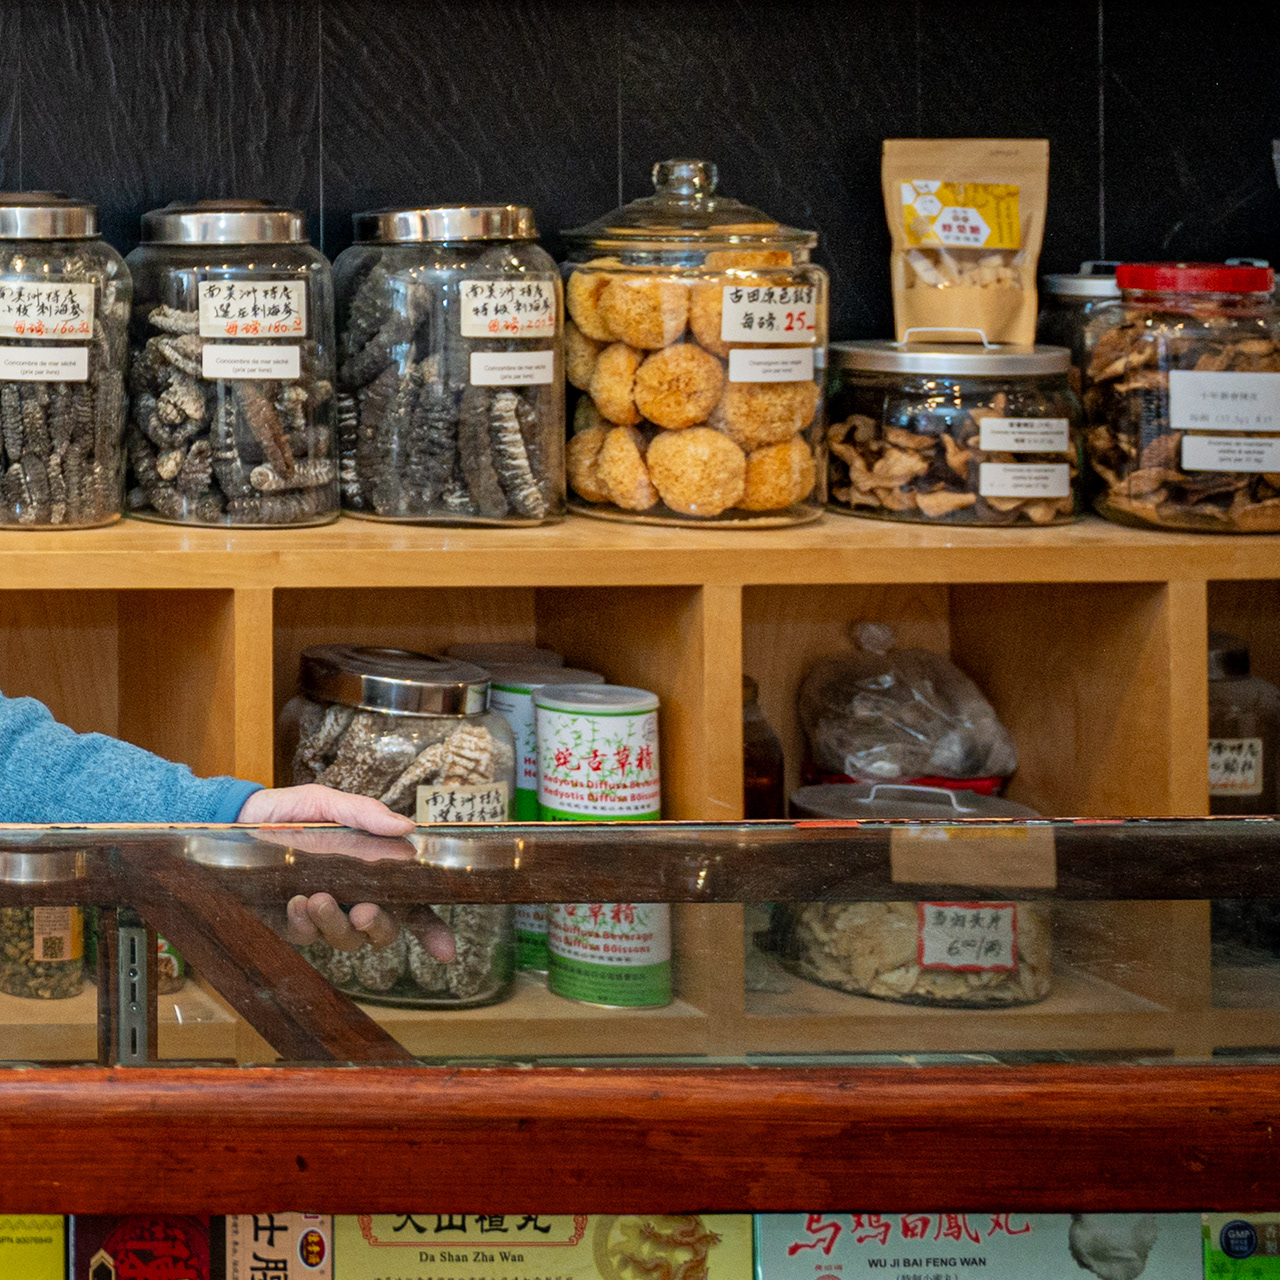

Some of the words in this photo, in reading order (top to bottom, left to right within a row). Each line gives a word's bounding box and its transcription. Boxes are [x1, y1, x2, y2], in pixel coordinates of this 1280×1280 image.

[554, 746, 654, 777] 蛇舌草精
[587, 779, 628, 791] Diffusa
[587, 792, 628, 803] Diffusa
[419, 1251, 436, 1263] Da
[440, 1251, 468, 1263] Shan
[473, 1251, 494, 1263] Zha
[499, 1251, 524, 1263] Wan
[868, 1258, 887, 1268] WU
[890, 1258, 900, 1268] JI
[903, 1258, 922, 1268] BAI
[926, 1258, 957, 1268] FENG
[960, 1258, 986, 1268] WAN
